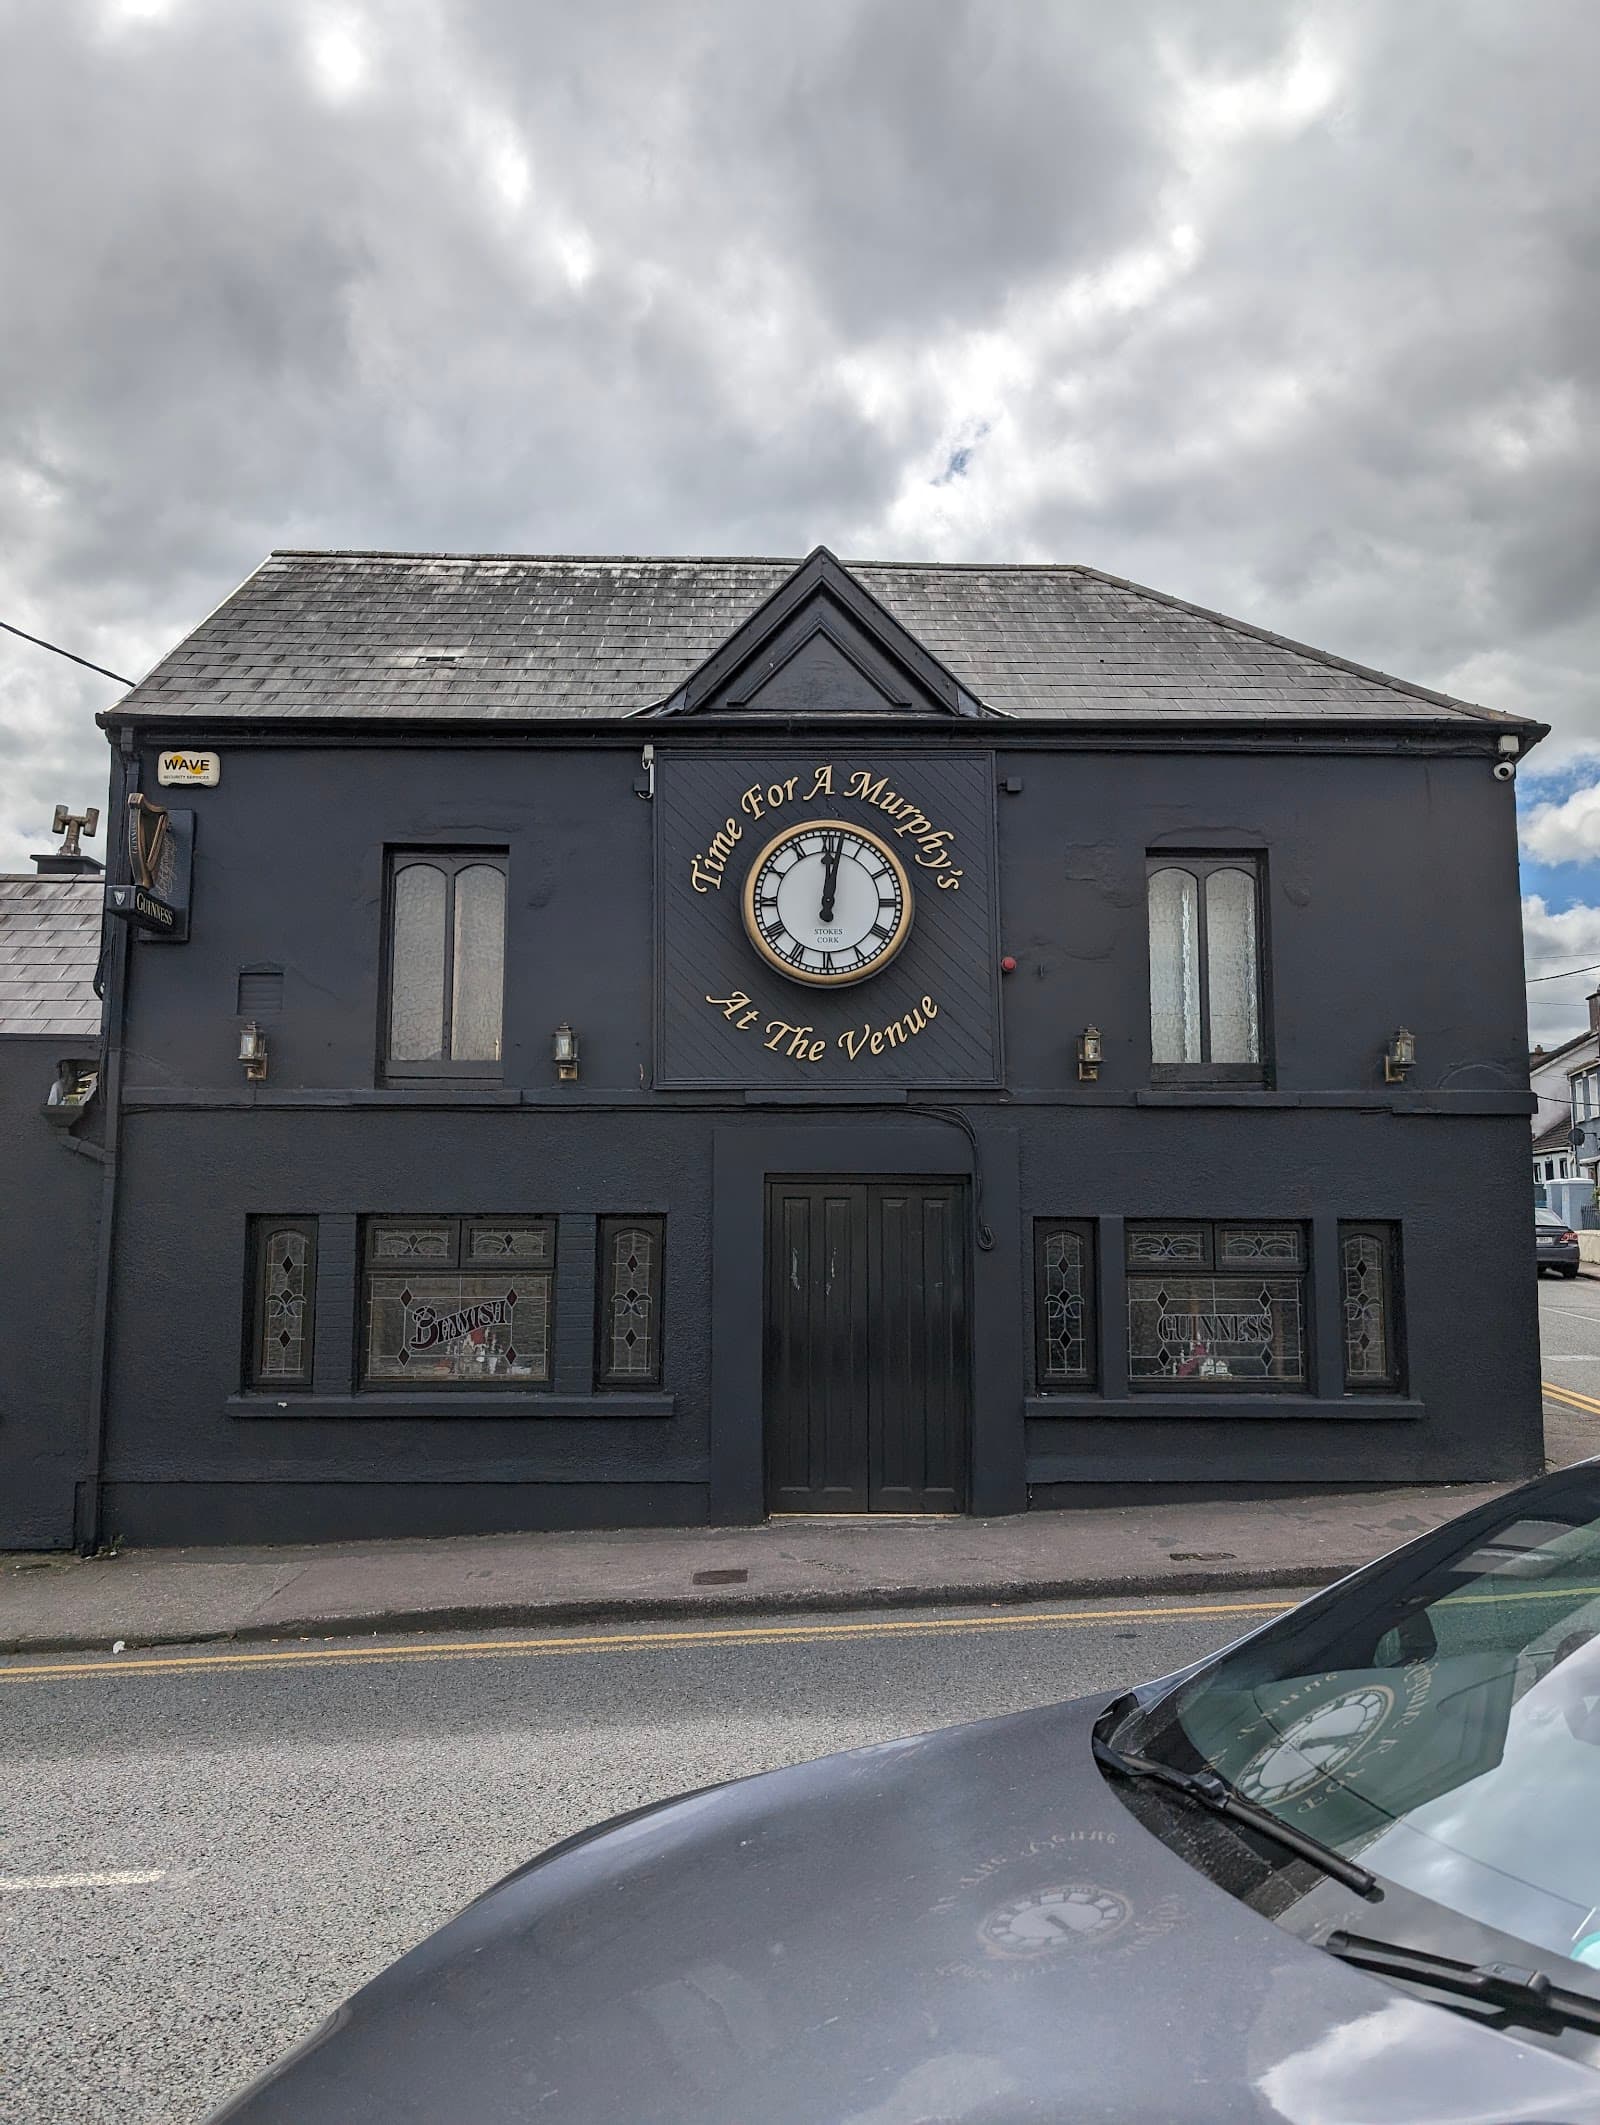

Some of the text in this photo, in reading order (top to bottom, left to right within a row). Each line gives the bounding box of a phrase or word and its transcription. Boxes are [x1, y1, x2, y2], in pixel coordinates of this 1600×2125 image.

[164, 759, 210, 771] WAVE
[690, 764, 964, 893] Time For A Murphy's
[136, 892, 173, 926] GUINNESS
[705, 990, 938, 1062] At The Venue
[408, 1299, 508, 1351] BEAMISH
[1157, 1315, 1274, 1342] GUINNESS
